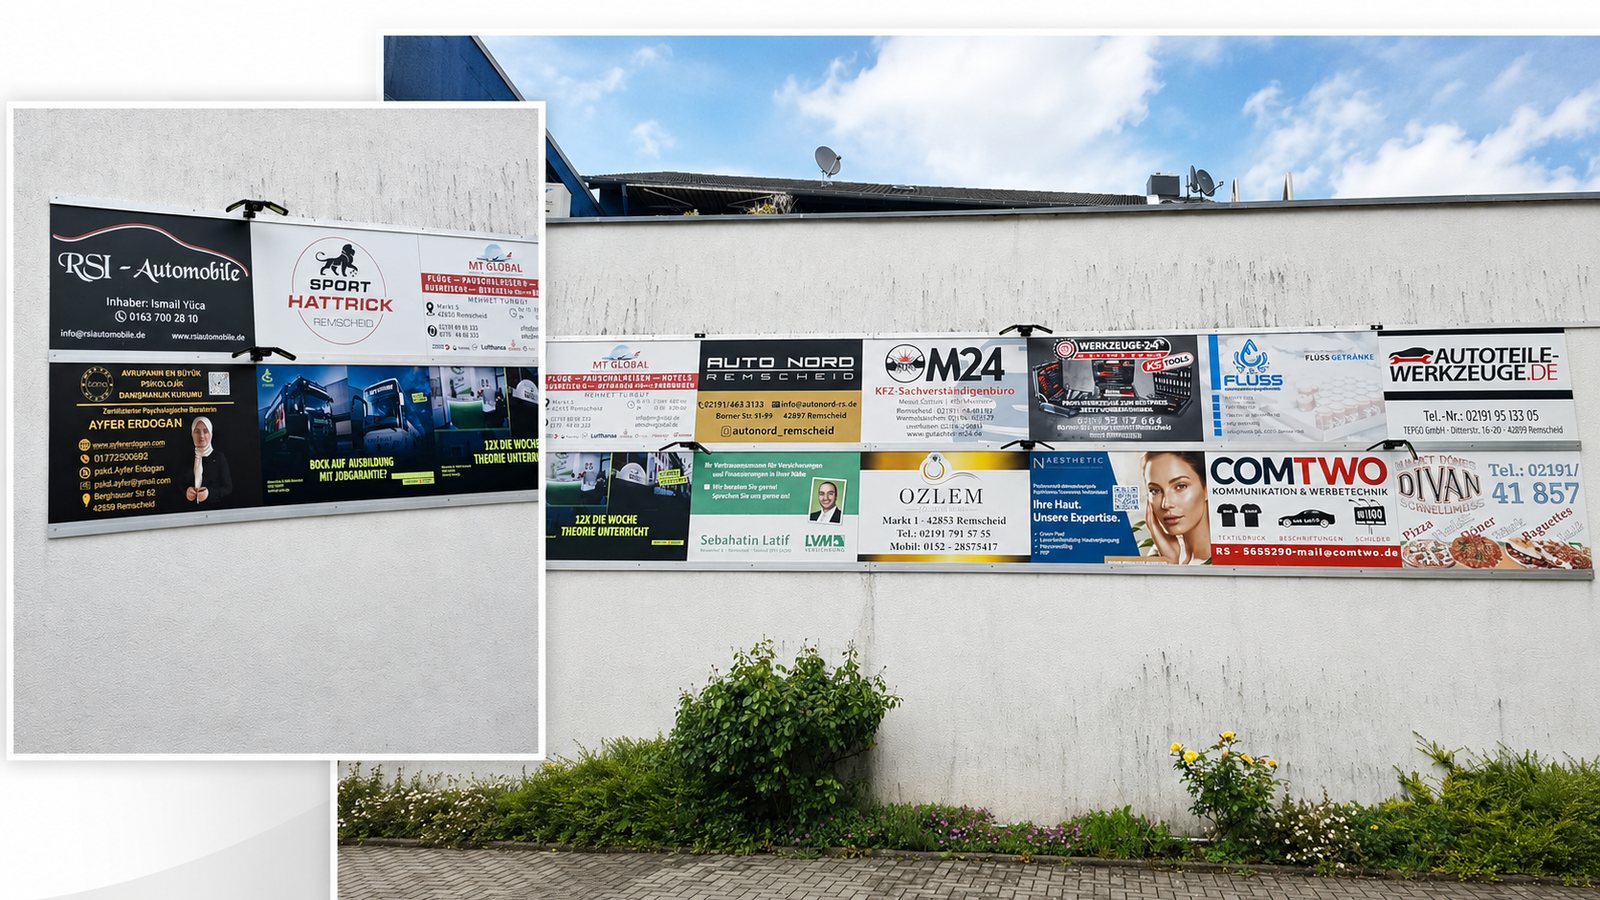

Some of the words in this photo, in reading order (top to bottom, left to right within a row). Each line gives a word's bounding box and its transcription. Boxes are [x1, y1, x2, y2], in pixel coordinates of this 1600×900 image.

[58, 252, 111, 282] RSI
[133, 258, 240, 283] Automobile
[469, 261, 483, 270] MT
[486, 262, 522, 272] GLOBAL
[310, 279, 371, 292] SPORT
[106, 297, 149, 308] Inhaber:
[151, 299, 180, 309] Ismail
[183, 299, 206, 310] Yüca
[288, 295, 393, 312] HATTRICK
[130, 311, 151, 321] 0163
[154, 312, 172, 322] 700
[174, 313, 185, 322] 28
[187, 313, 198, 323] 10
[313, 318, 374, 327] REMSCHEID
[61, 330, 145, 339] info@rsiautomobile.de
[172, 333, 245, 341] www.rsiautomobile.de
[1434, 347, 1559, 364] AUTOTEILE-
[593, 361, 608, 369] MT
[611, 361, 649, 369] GLOBAL
[707, 358, 774, 368] AUTO
[788, 357, 854, 368] NORD
[926, 347, 1004, 381] M24
[1146, 361, 1161, 371] KS
[1165, 356, 1189, 366] TOOLS
[1389, 364, 1558, 382] WERKZEUGE.DE
[875, 387, 1014, 397] KFZ-Sachverständigenbüro
[1424, 410, 1463, 421] Tel.-Nr.:
[1465, 410, 1491, 421] 02191
[1495, 410, 1506, 421] 95
[1509, 410, 1524, 421] 133
[1527, 410, 1539, 421] 05
[89, 419, 125, 430] AYFER
[128, 418, 182, 428] ERDOGAN
[1425, 426, 1445, 434] GmbH
[733, 426, 834, 437] autonord_remscheid
[484, 440, 498, 451] 12X
[499, 439, 512, 449] DIE
[310, 459, 330, 470] BOCK
[331, 459, 346, 468] AUF
[348, 457, 394, 468] AUSBILDUNG
[473, 453, 506, 465] THEORIE
[1033, 457, 1045, 469] N
[135, 465, 164, 474] Erdogan
[319, 470, 333, 482] MIT
[335, 469, 387, 481] JOBGARANTIE?
[1210, 457, 1388, 485] COMTWO
[1488, 463, 1523, 477] Tel.:
[1528, 464, 1579, 477] 02191/
[1397, 466, 1481, 504] DIVAN
[899, 488, 983, 504] OZLEM
[1309, 488, 1388, 496] WERBETECHNIK
[1492, 483, 1524, 504] 41
[1533, 482, 1580, 504] 857
[117, 501, 155, 510] Remscheid
[1033, 500, 1053, 509] Ihre
[1055, 500, 1081, 509] Haut.
[576, 515, 590, 524] 12X
[592, 515, 606, 524] DIE
[608, 515, 638, 524] WOCHE
[882, 517, 912, 525] Markt
[957, 516, 1007, 525] Remscheid
[1033, 513, 1068, 522] Unsere
[1071, 512, 1120, 524] Expertise.
[1402, 519, 1434, 540] Pizza
[1521, 506, 1573, 543] Baguettes
[561, 527, 595, 536] THEORIE
[598, 527, 649, 536] UNTERRICHT
[897, 530, 917, 538] Tel.:
[919, 530, 945, 538] 02191
[701, 535, 759, 545] Sebahatin
[763, 535, 790, 545] Latif
[806, 535, 832, 547] LVM
[1243, 548, 1398, 557] 5655290-mail@comtwo.de
